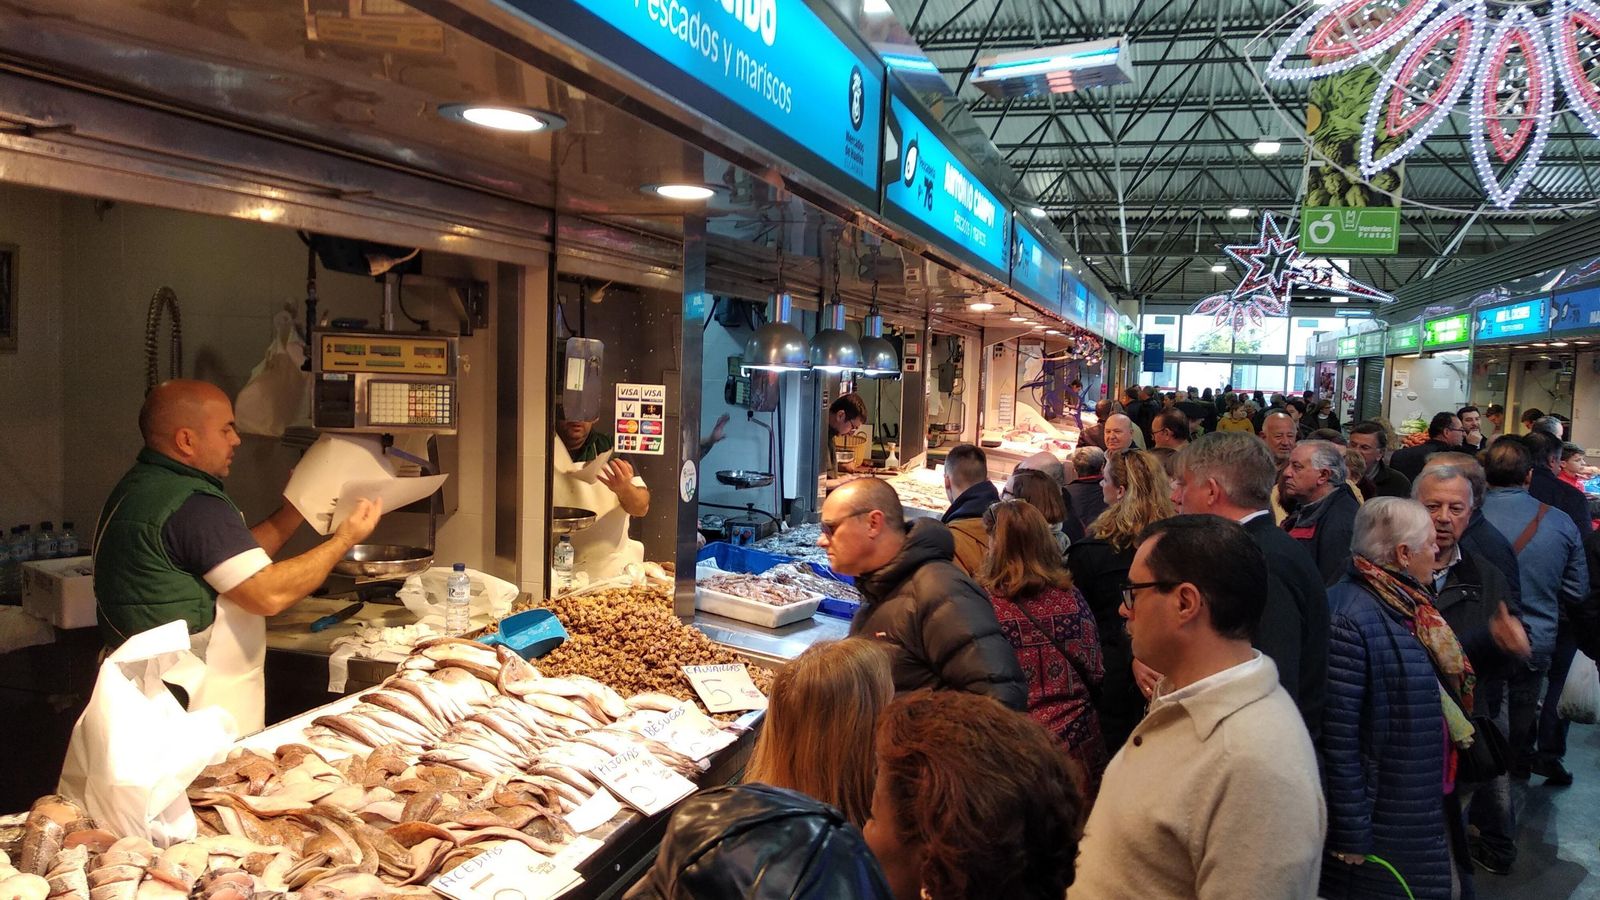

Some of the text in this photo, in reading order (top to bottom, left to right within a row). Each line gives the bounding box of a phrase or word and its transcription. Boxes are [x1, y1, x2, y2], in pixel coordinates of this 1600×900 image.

[634, 0, 793, 114] escados y mariscos
[944, 161, 974, 212] ANTONIO
[620, 388, 662, 397] VISA VISA
[701, 679, 733, 706] 5
[643, 705, 686, 737] BESUGOS
